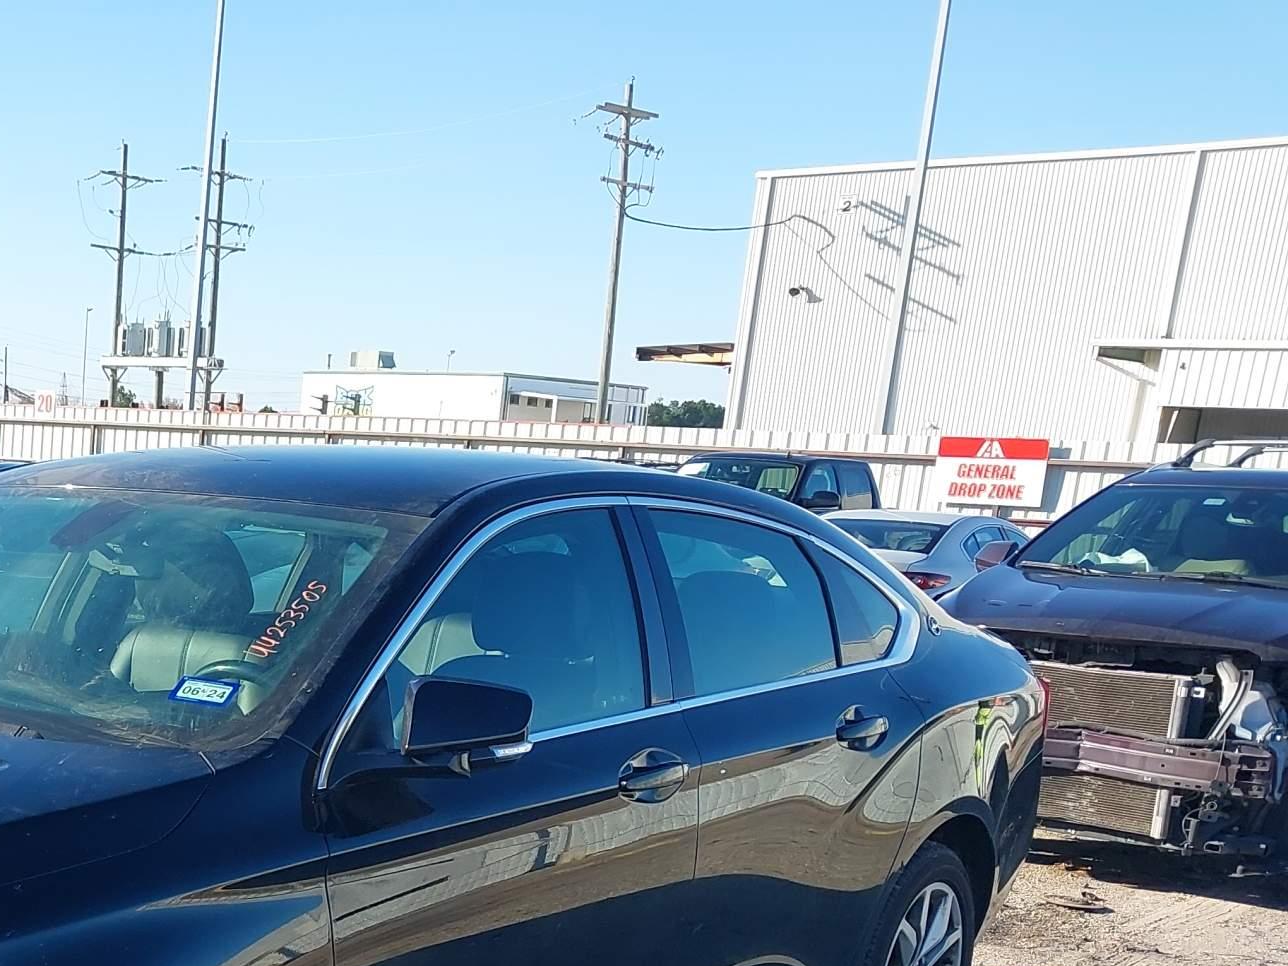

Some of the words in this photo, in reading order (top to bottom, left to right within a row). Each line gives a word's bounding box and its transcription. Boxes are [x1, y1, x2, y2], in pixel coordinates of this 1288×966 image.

[842, 200, 852, 212] 2
[37, 393, 53, 413] 20
[957, 463, 1016, 480] GENERAL
[948, 482, 986, 498] DROP
[987, 483, 1025, 500] ZONE
[243, 580, 327, 658] 44253505
[182, 685, 202, 696] 06
[206, 689, 227, 699] 24
